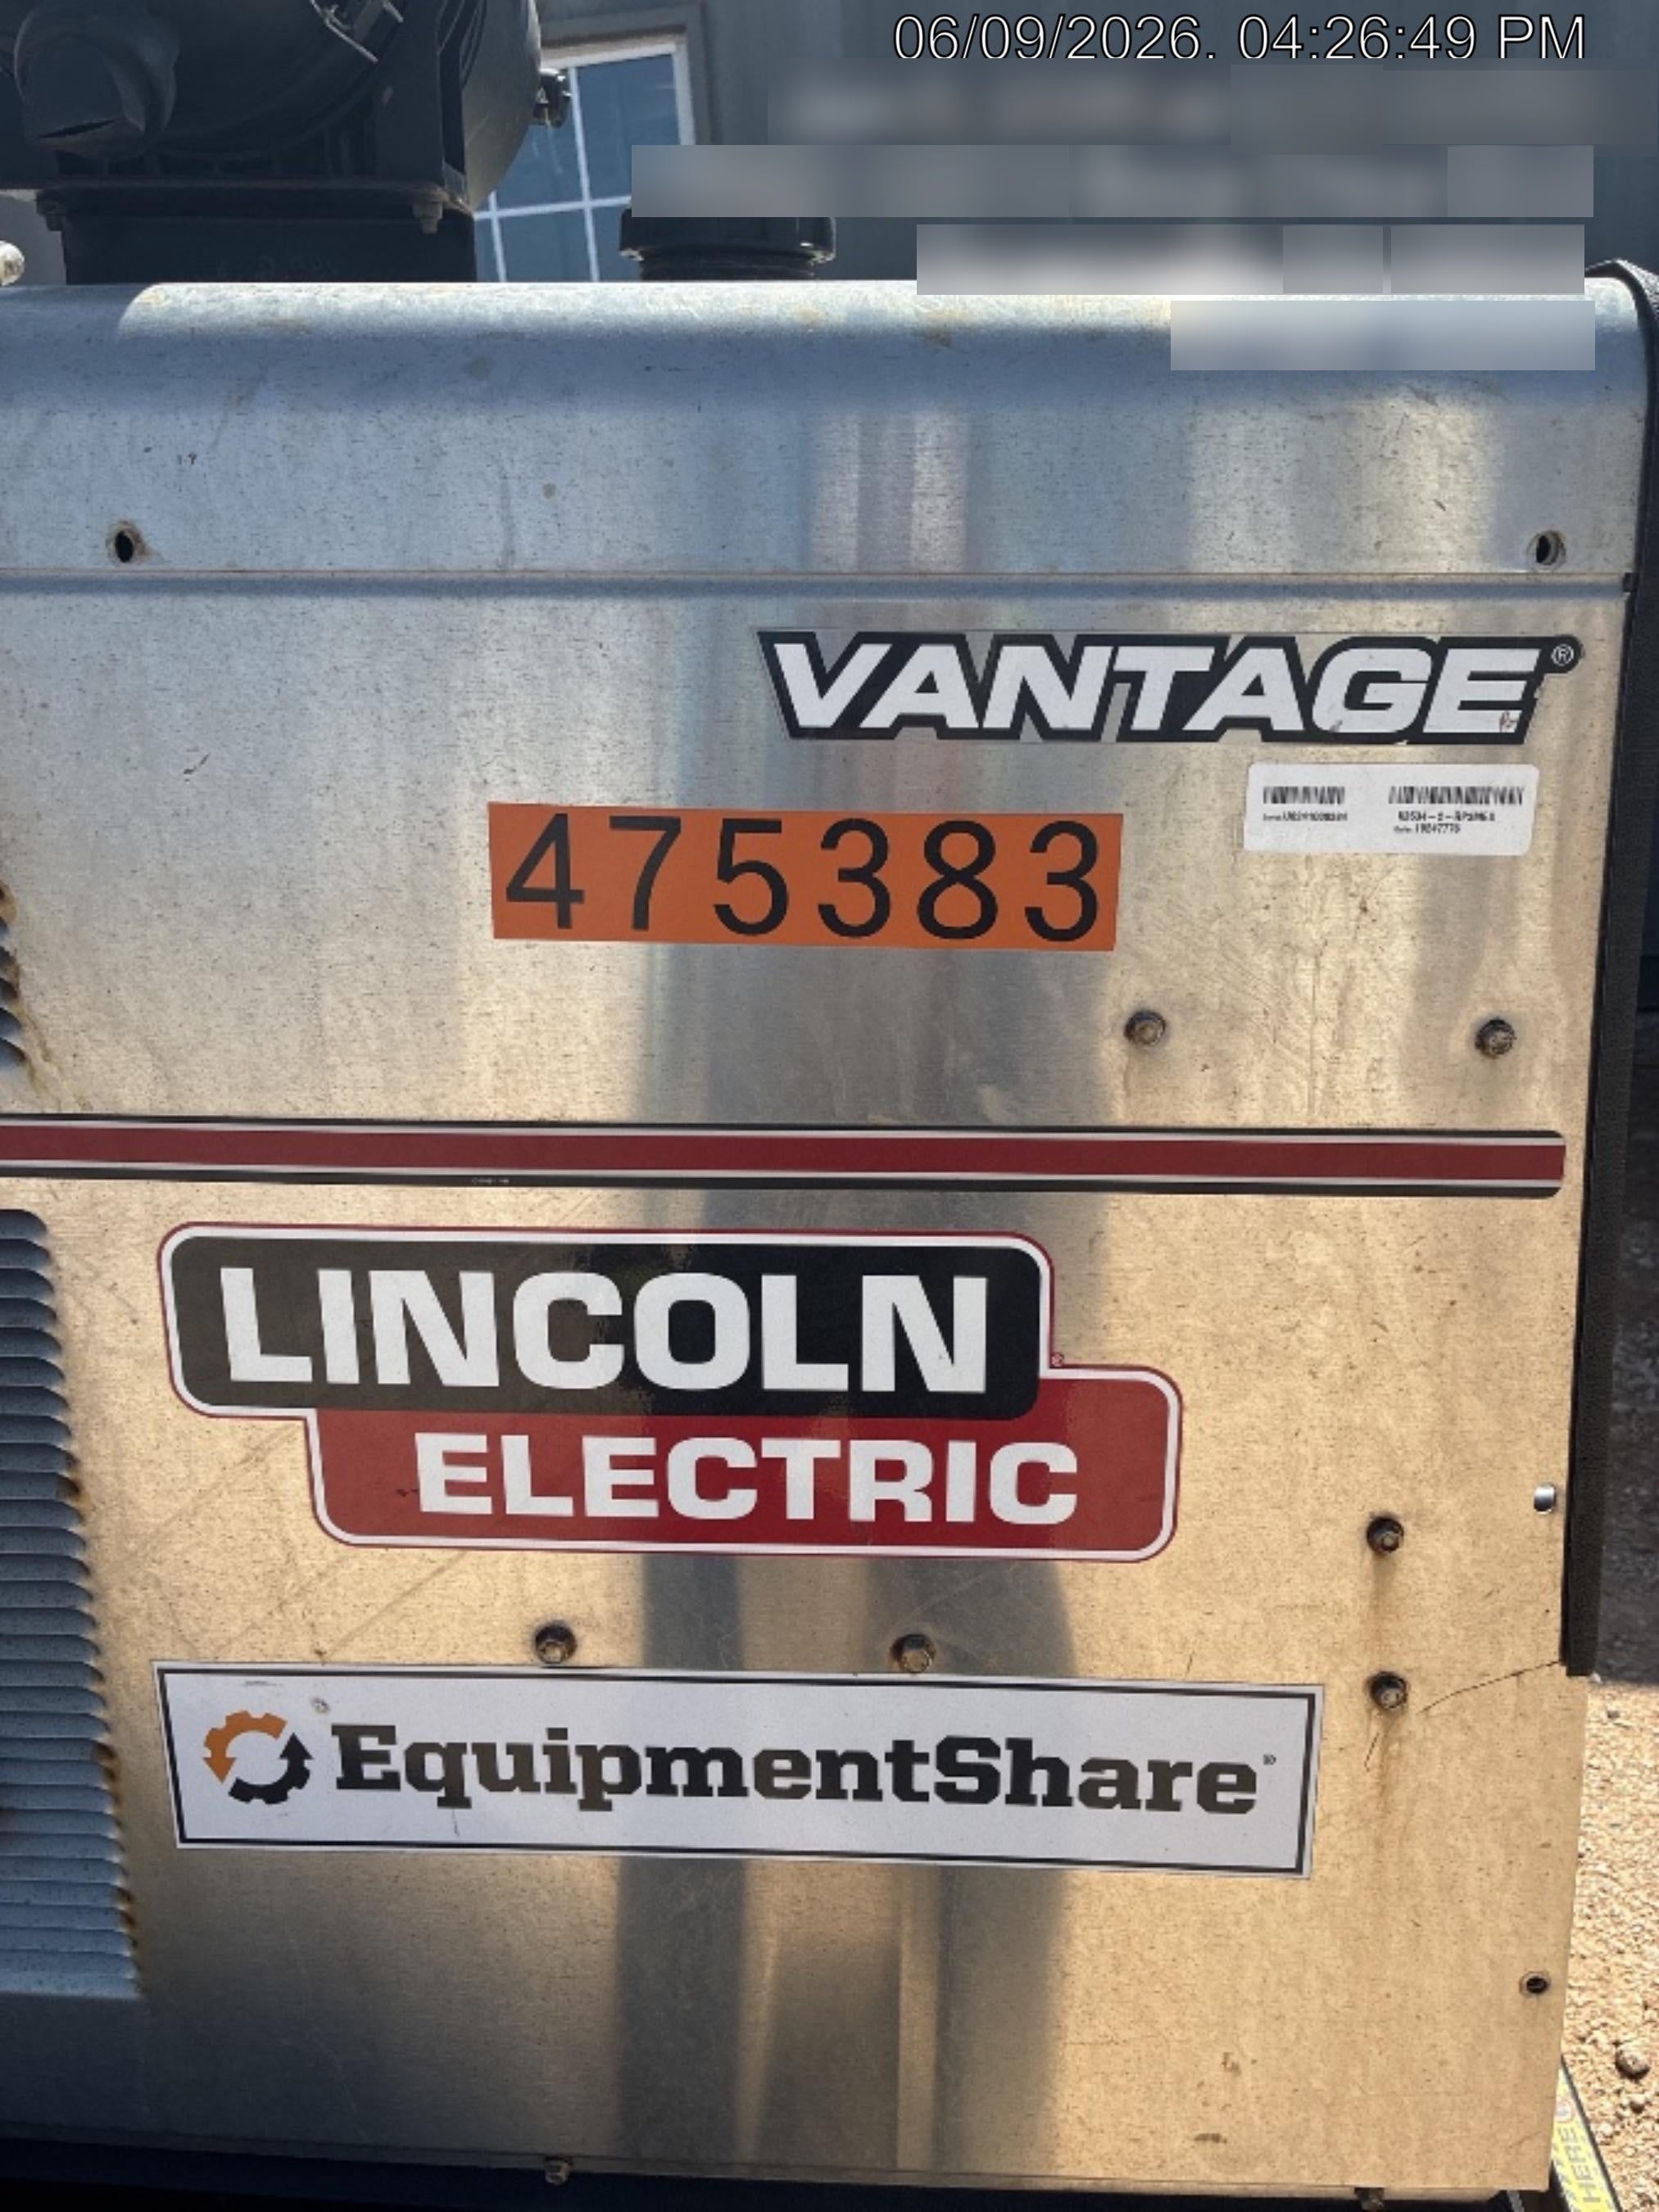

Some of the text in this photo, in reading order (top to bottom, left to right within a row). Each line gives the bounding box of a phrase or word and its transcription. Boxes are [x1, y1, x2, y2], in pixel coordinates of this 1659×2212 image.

[505, 813, 1099, 942] 475383
[220, 1267, 988, 1394] LINCOLN
[415, 1432, 1078, 1525] ELECTRIC
[332, 1723, 1258, 1815] EquipmentShare
